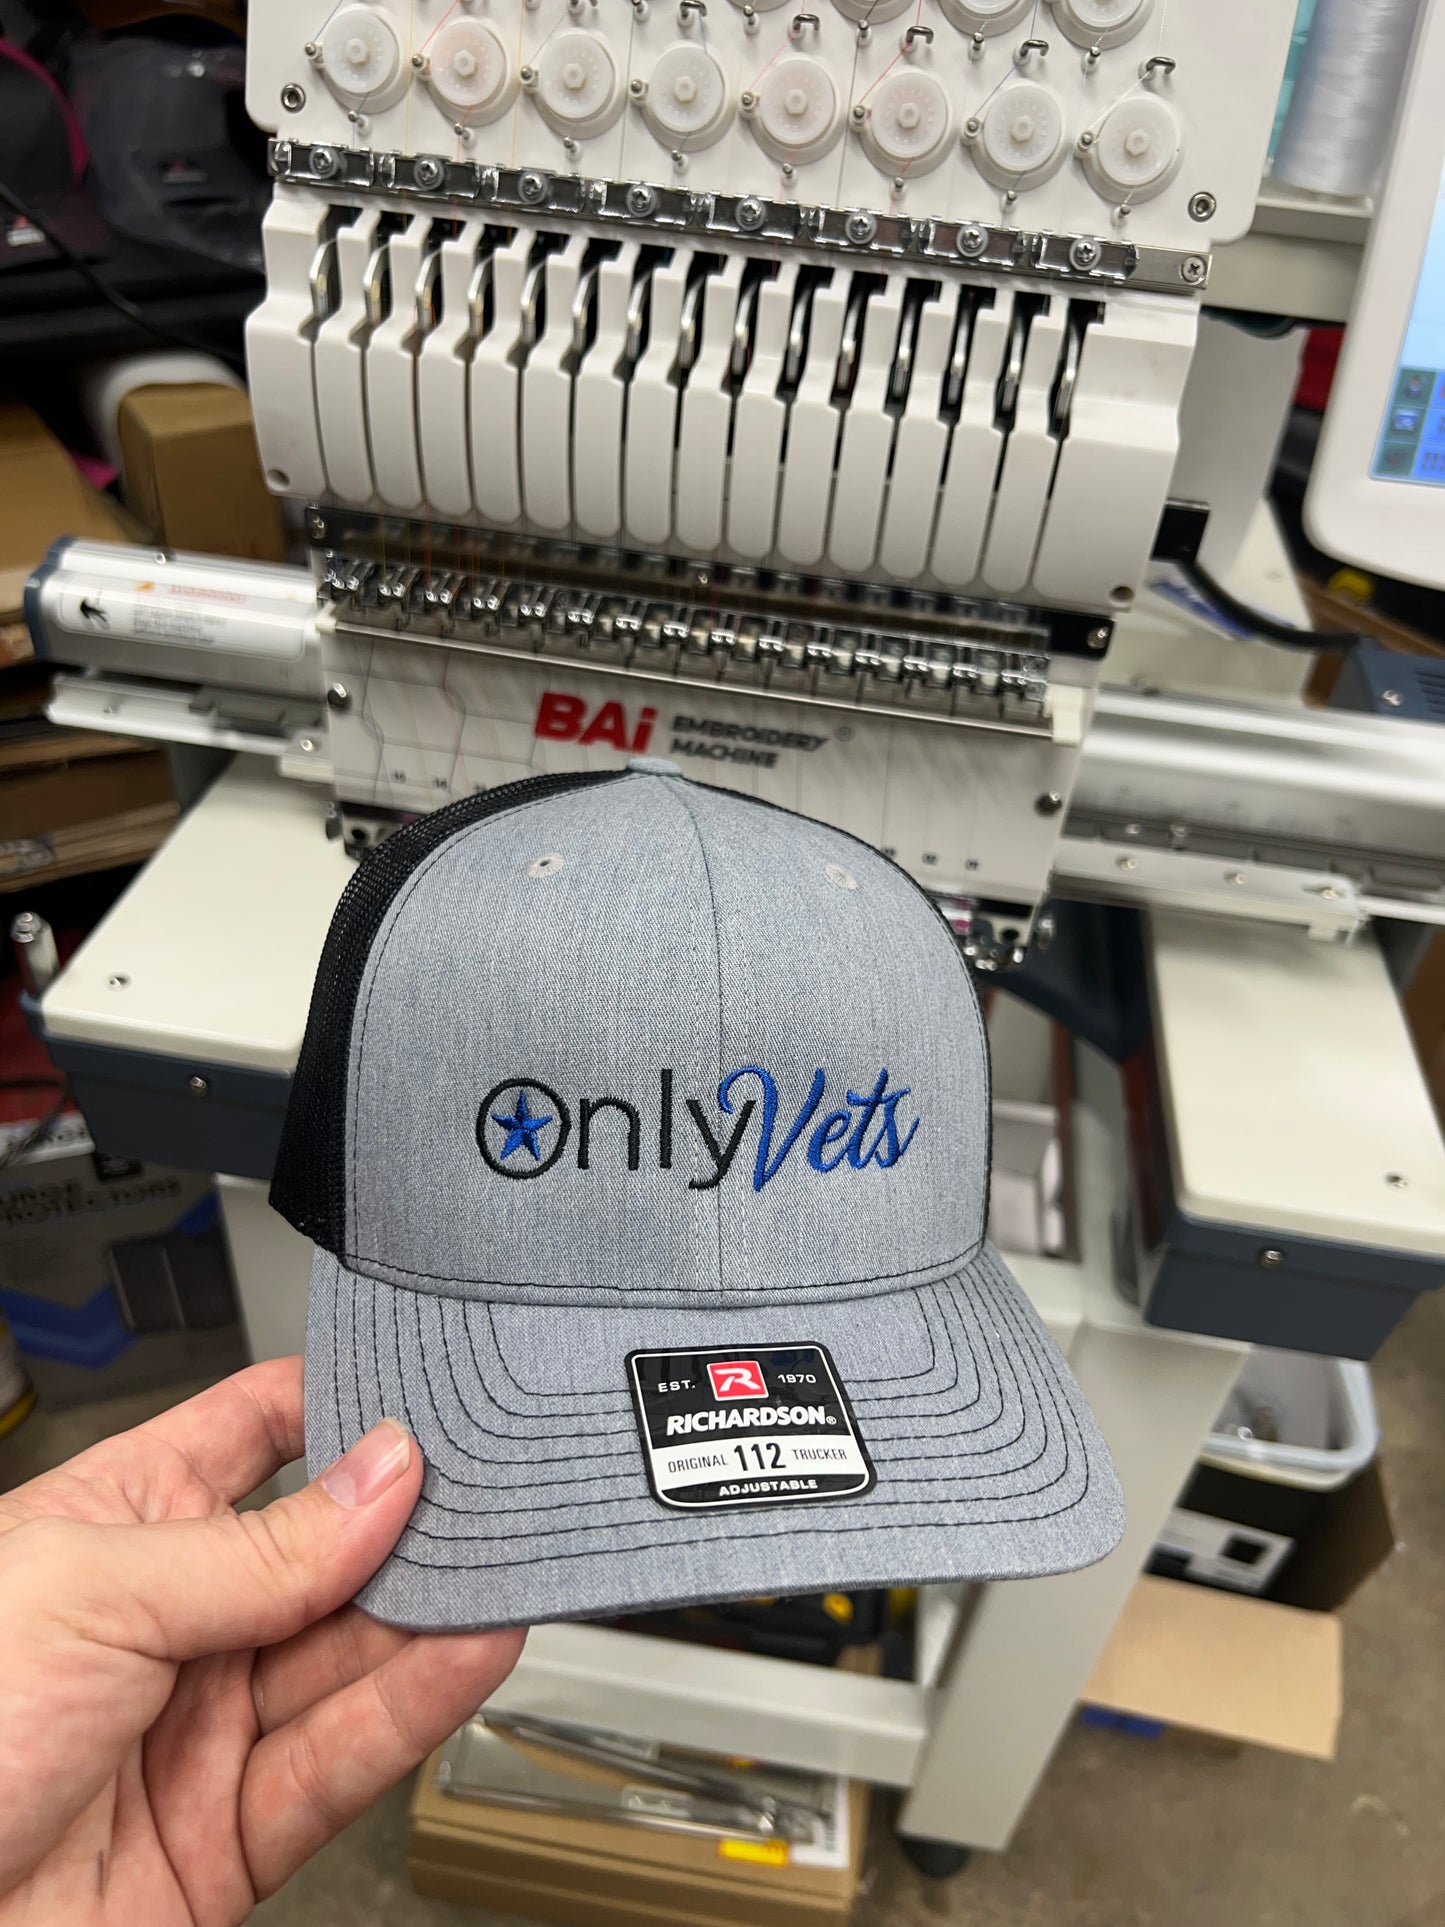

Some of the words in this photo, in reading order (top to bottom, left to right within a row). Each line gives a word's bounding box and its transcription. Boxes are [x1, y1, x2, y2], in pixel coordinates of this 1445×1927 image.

[671, 714, 830, 752] EMBROIDERY
[670, 738, 779, 769] MACHINE
[657, 1379, 696, 1393] EST.
[777, 1373, 817, 1385] 1970
[668, 1453, 728, 1473] ORIGINAL
[733, 1442, 786, 1471] 112
[791, 1448, 848, 1461] TRUCKER
[718, 1478, 818, 1497] ADJUSTABLE
